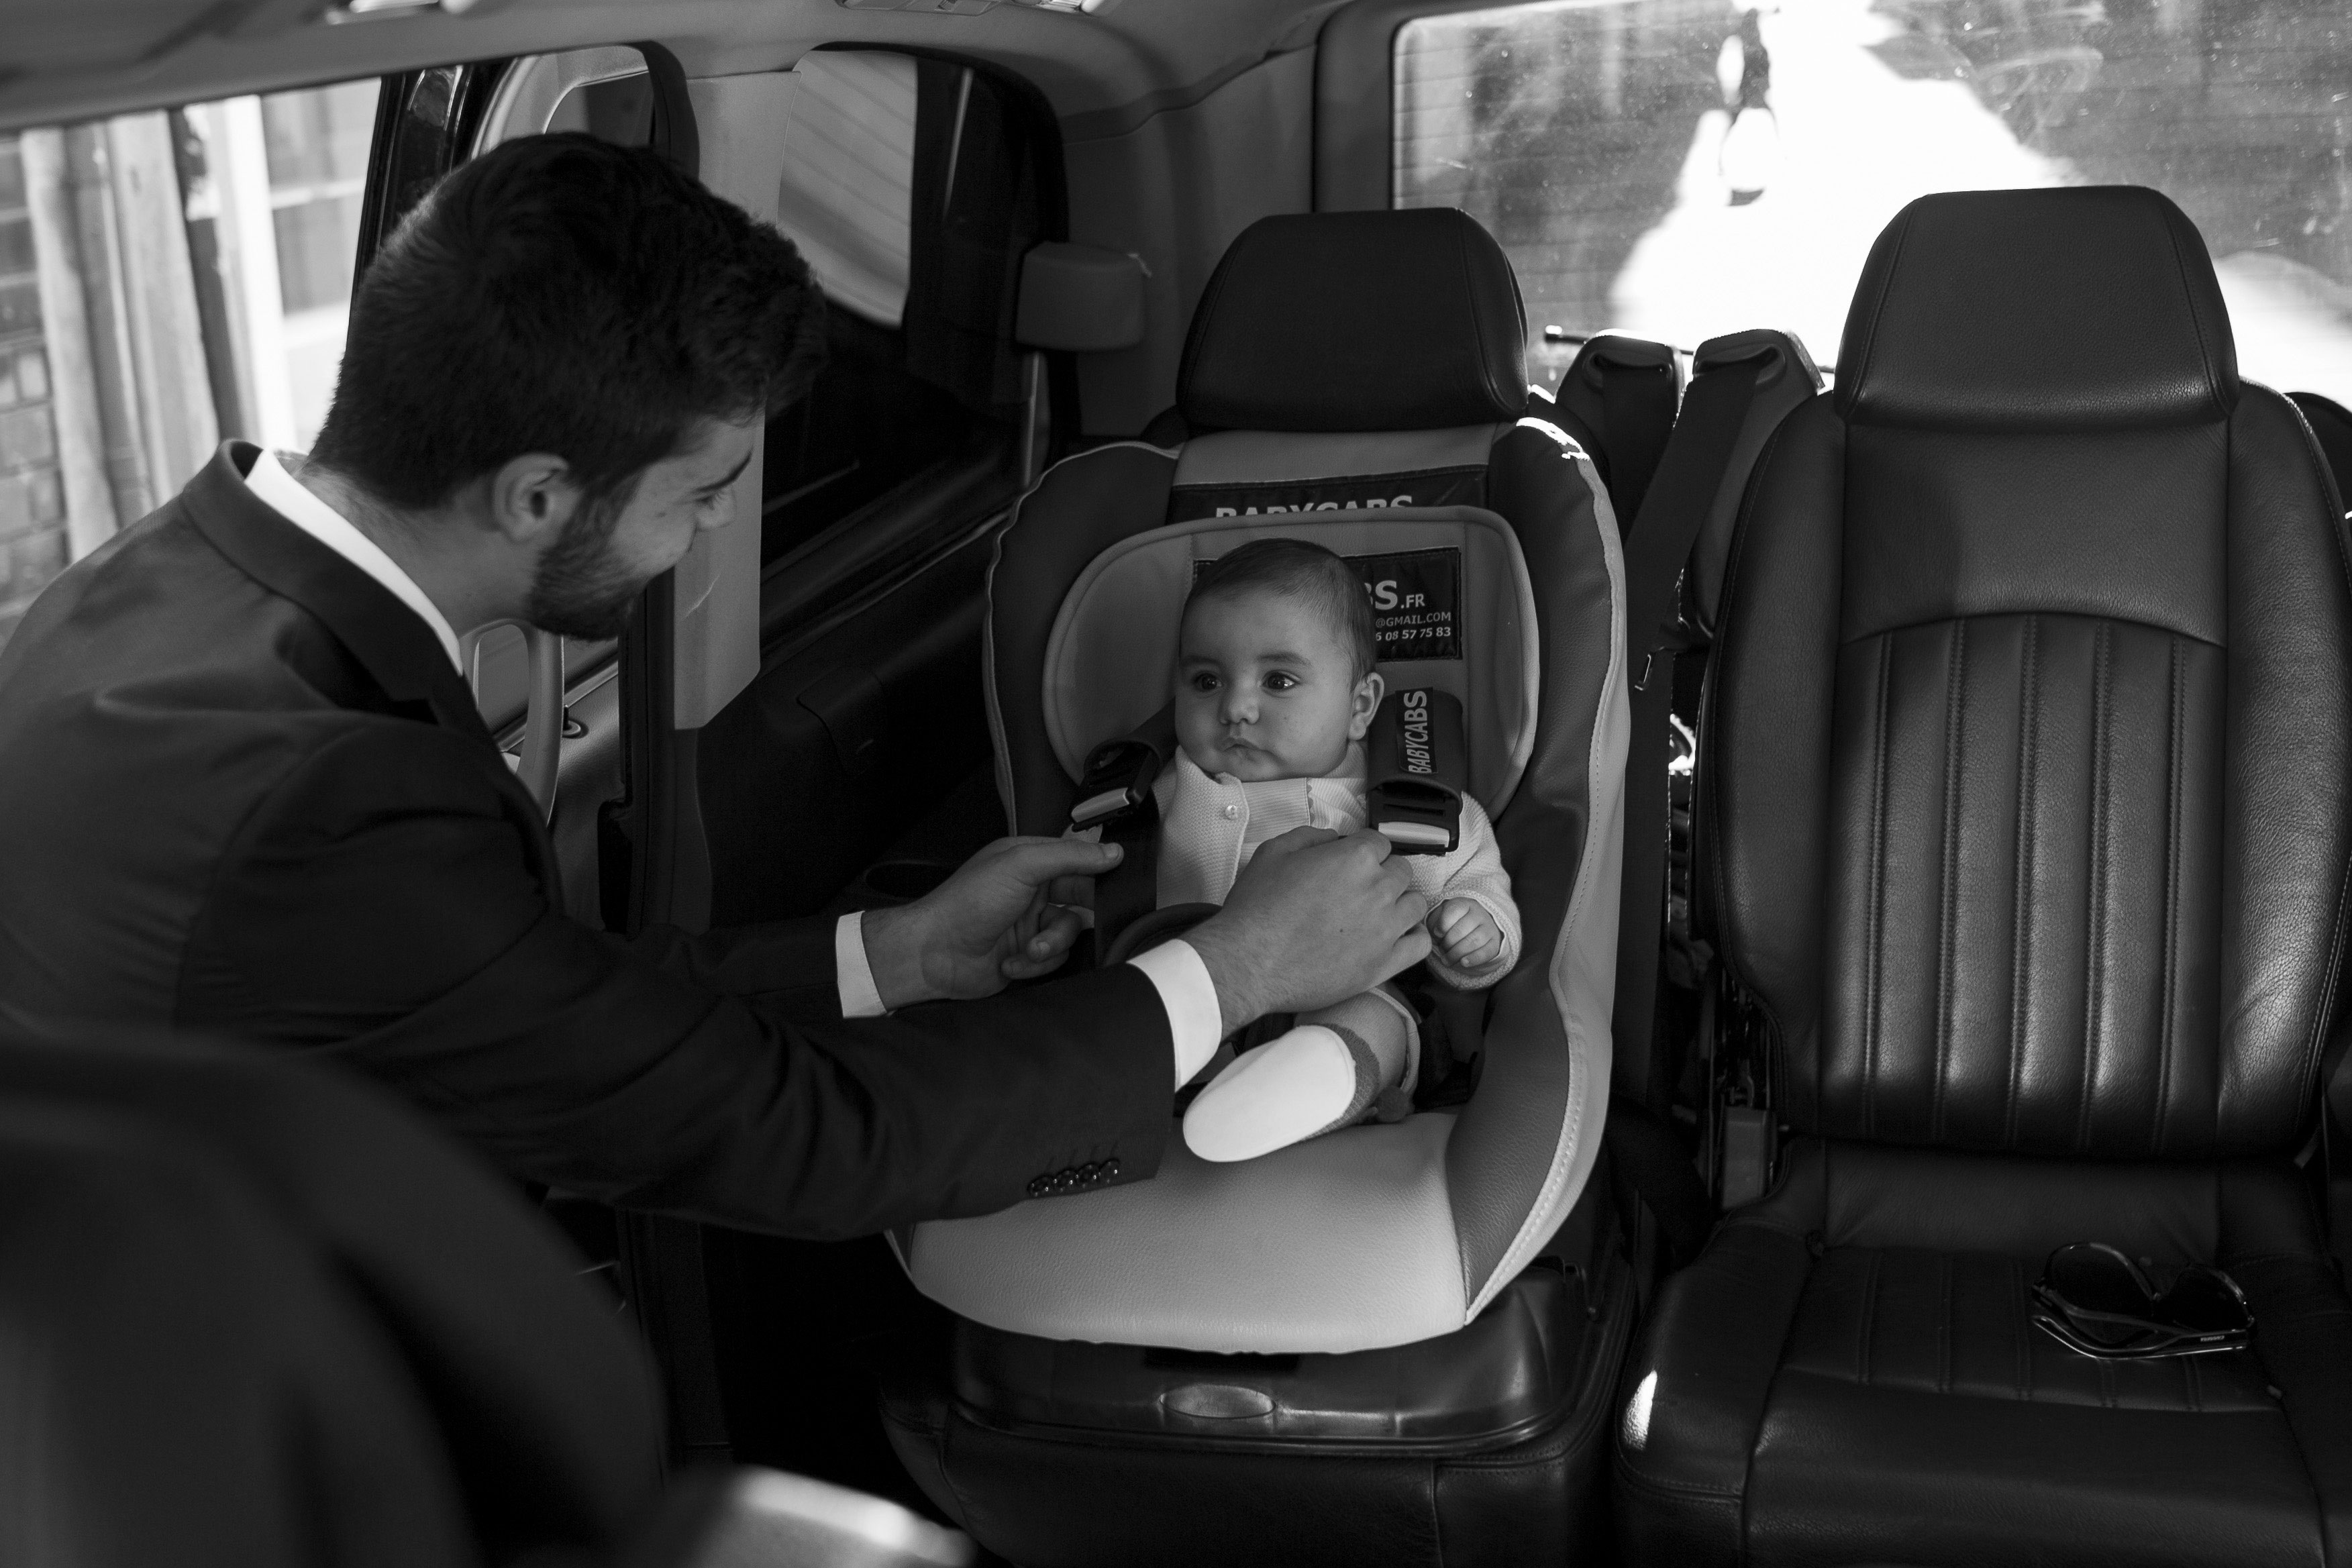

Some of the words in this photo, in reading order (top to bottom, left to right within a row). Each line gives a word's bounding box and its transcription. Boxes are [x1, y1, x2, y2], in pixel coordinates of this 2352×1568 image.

[1386, 631, 1398, 641] 08
[1402, 630, 1417, 639] 57
[1420, 628, 1433, 638] 75
[1436, 627, 1451, 637] 83
[1403, 690, 1432, 773] BABYCABS
